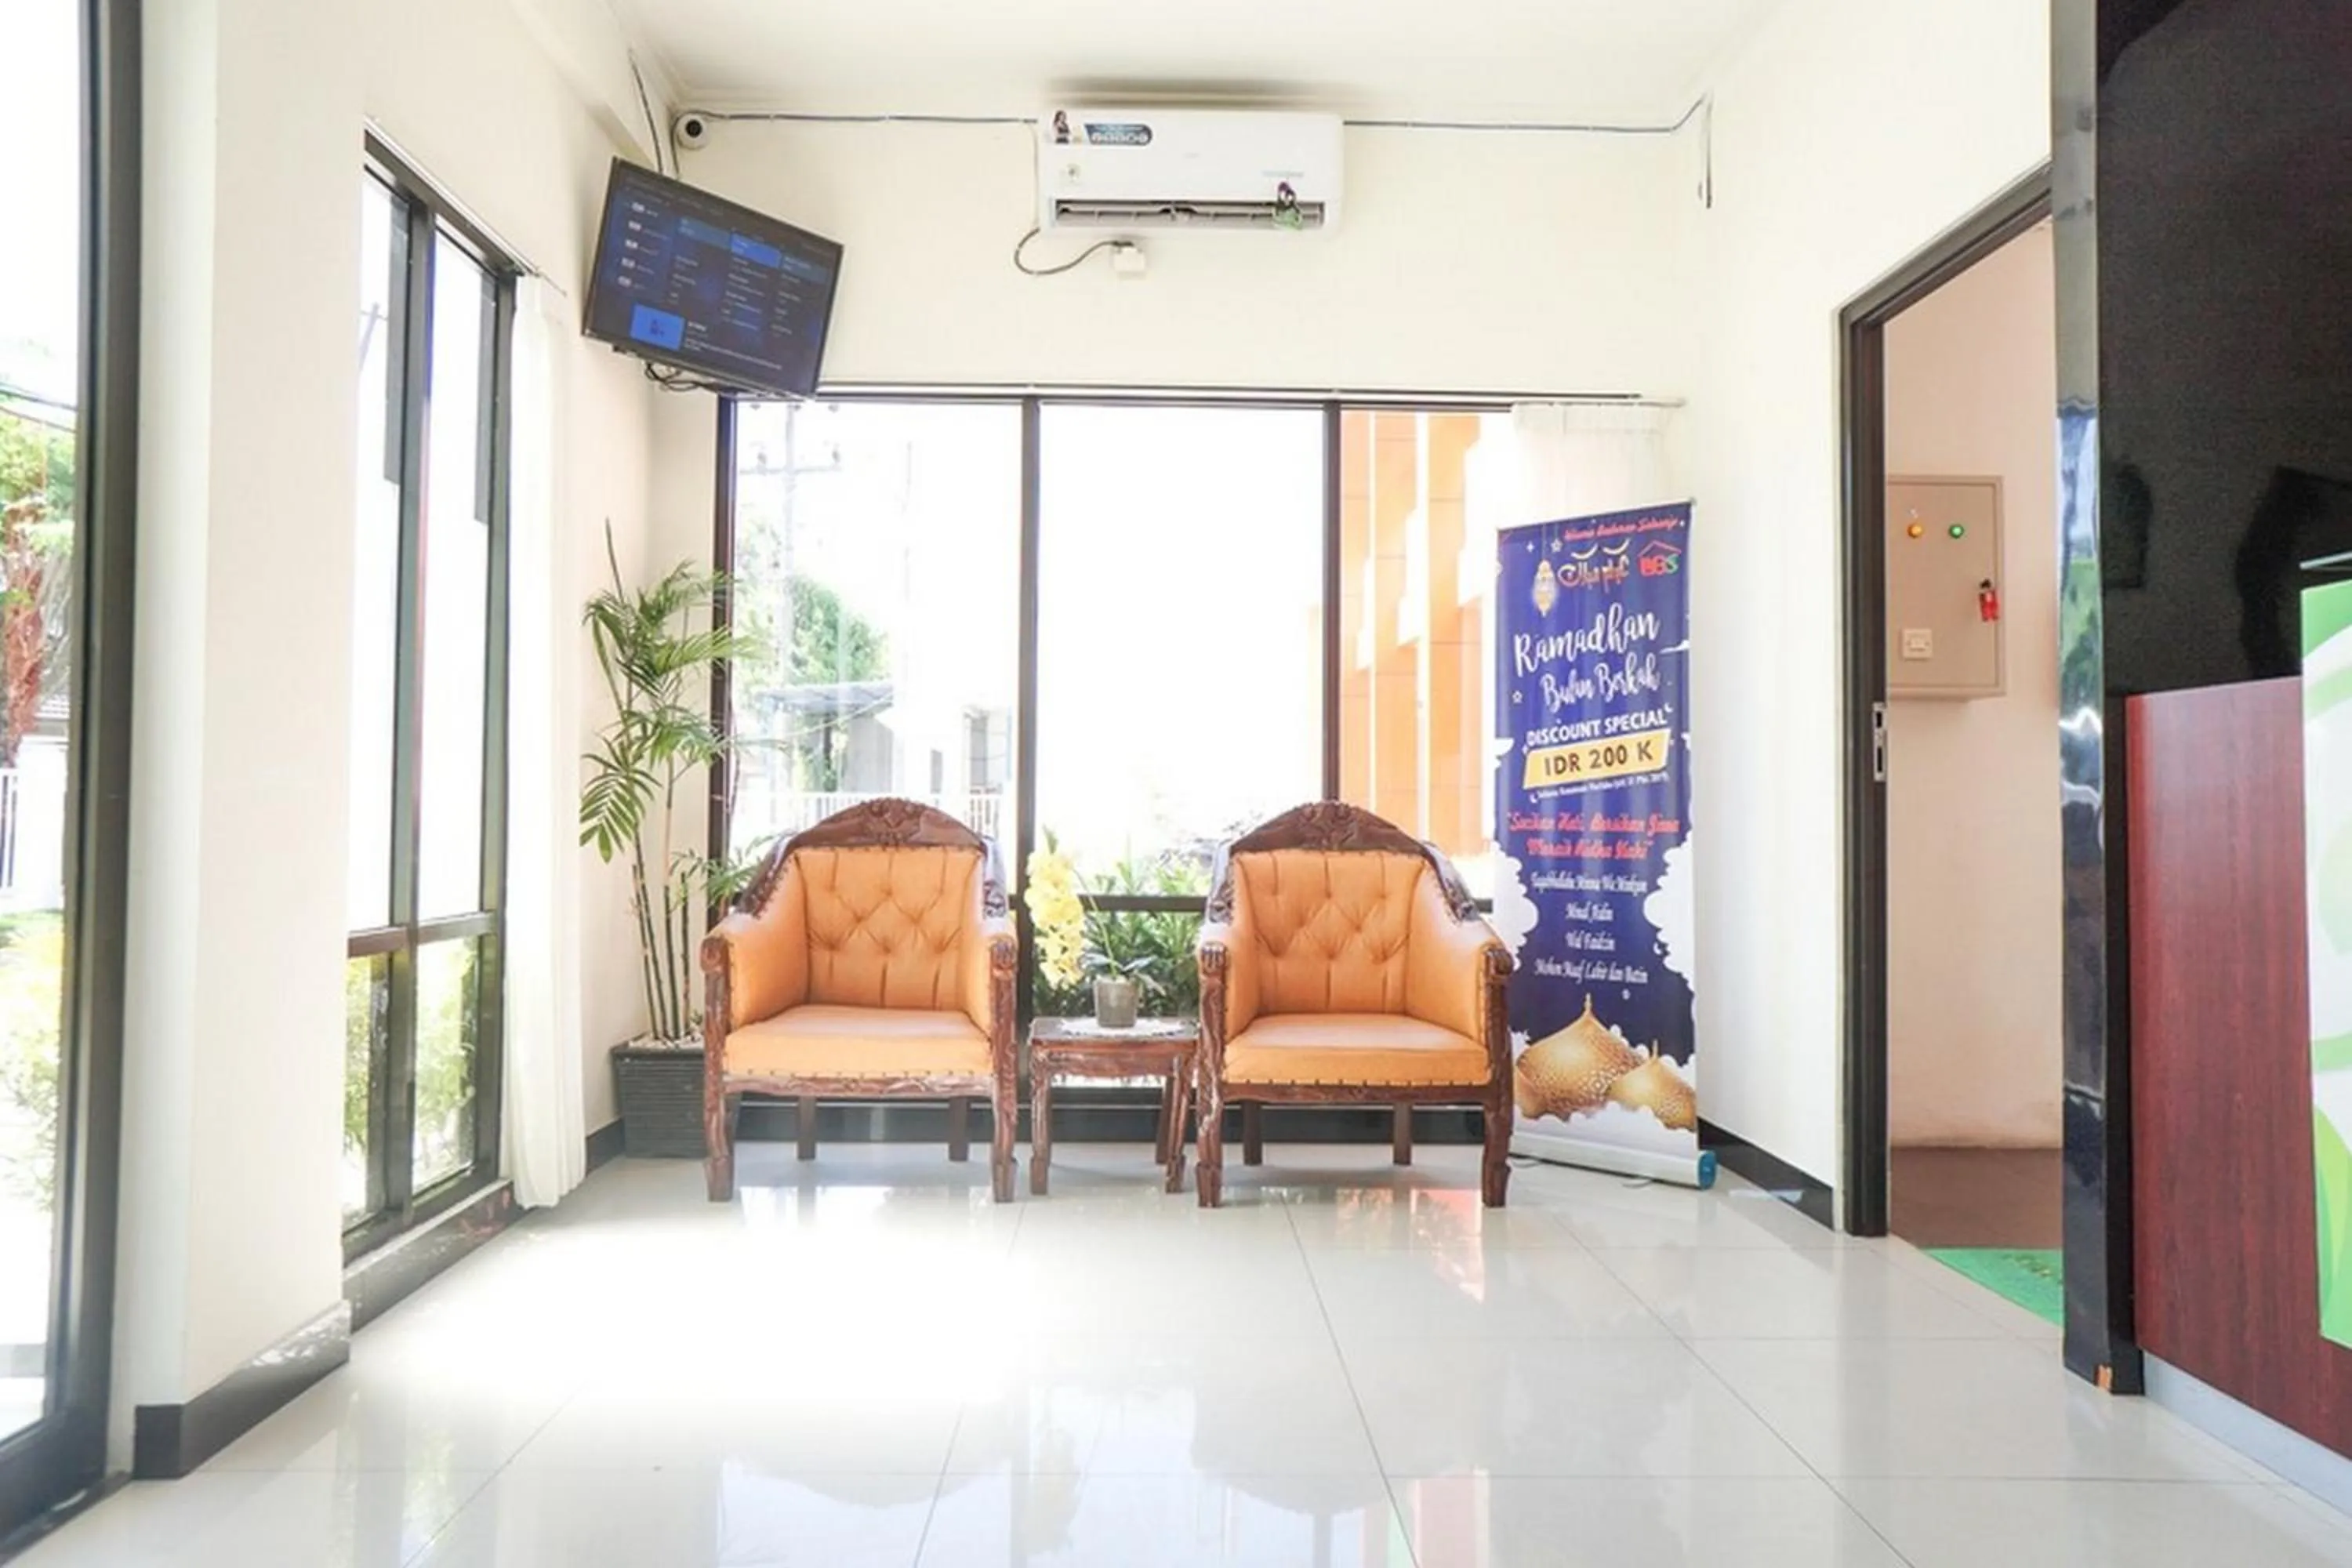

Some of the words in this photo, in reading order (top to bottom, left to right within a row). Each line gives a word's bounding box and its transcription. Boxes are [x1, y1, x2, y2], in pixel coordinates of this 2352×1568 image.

[1514, 603, 1660, 677] Ramadhan
[1541, 670, 1595, 713] Bulan
[1594, 652, 1660, 702] Berkah
[1526, 719, 1600, 746] DISCOUNT
[1605, 709, 1668, 734] SPECIAL
[1544, 753, 1581, 775] IDR
[1589, 745, 1628, 768] 200
[1638, 739, 1653, 762] K
